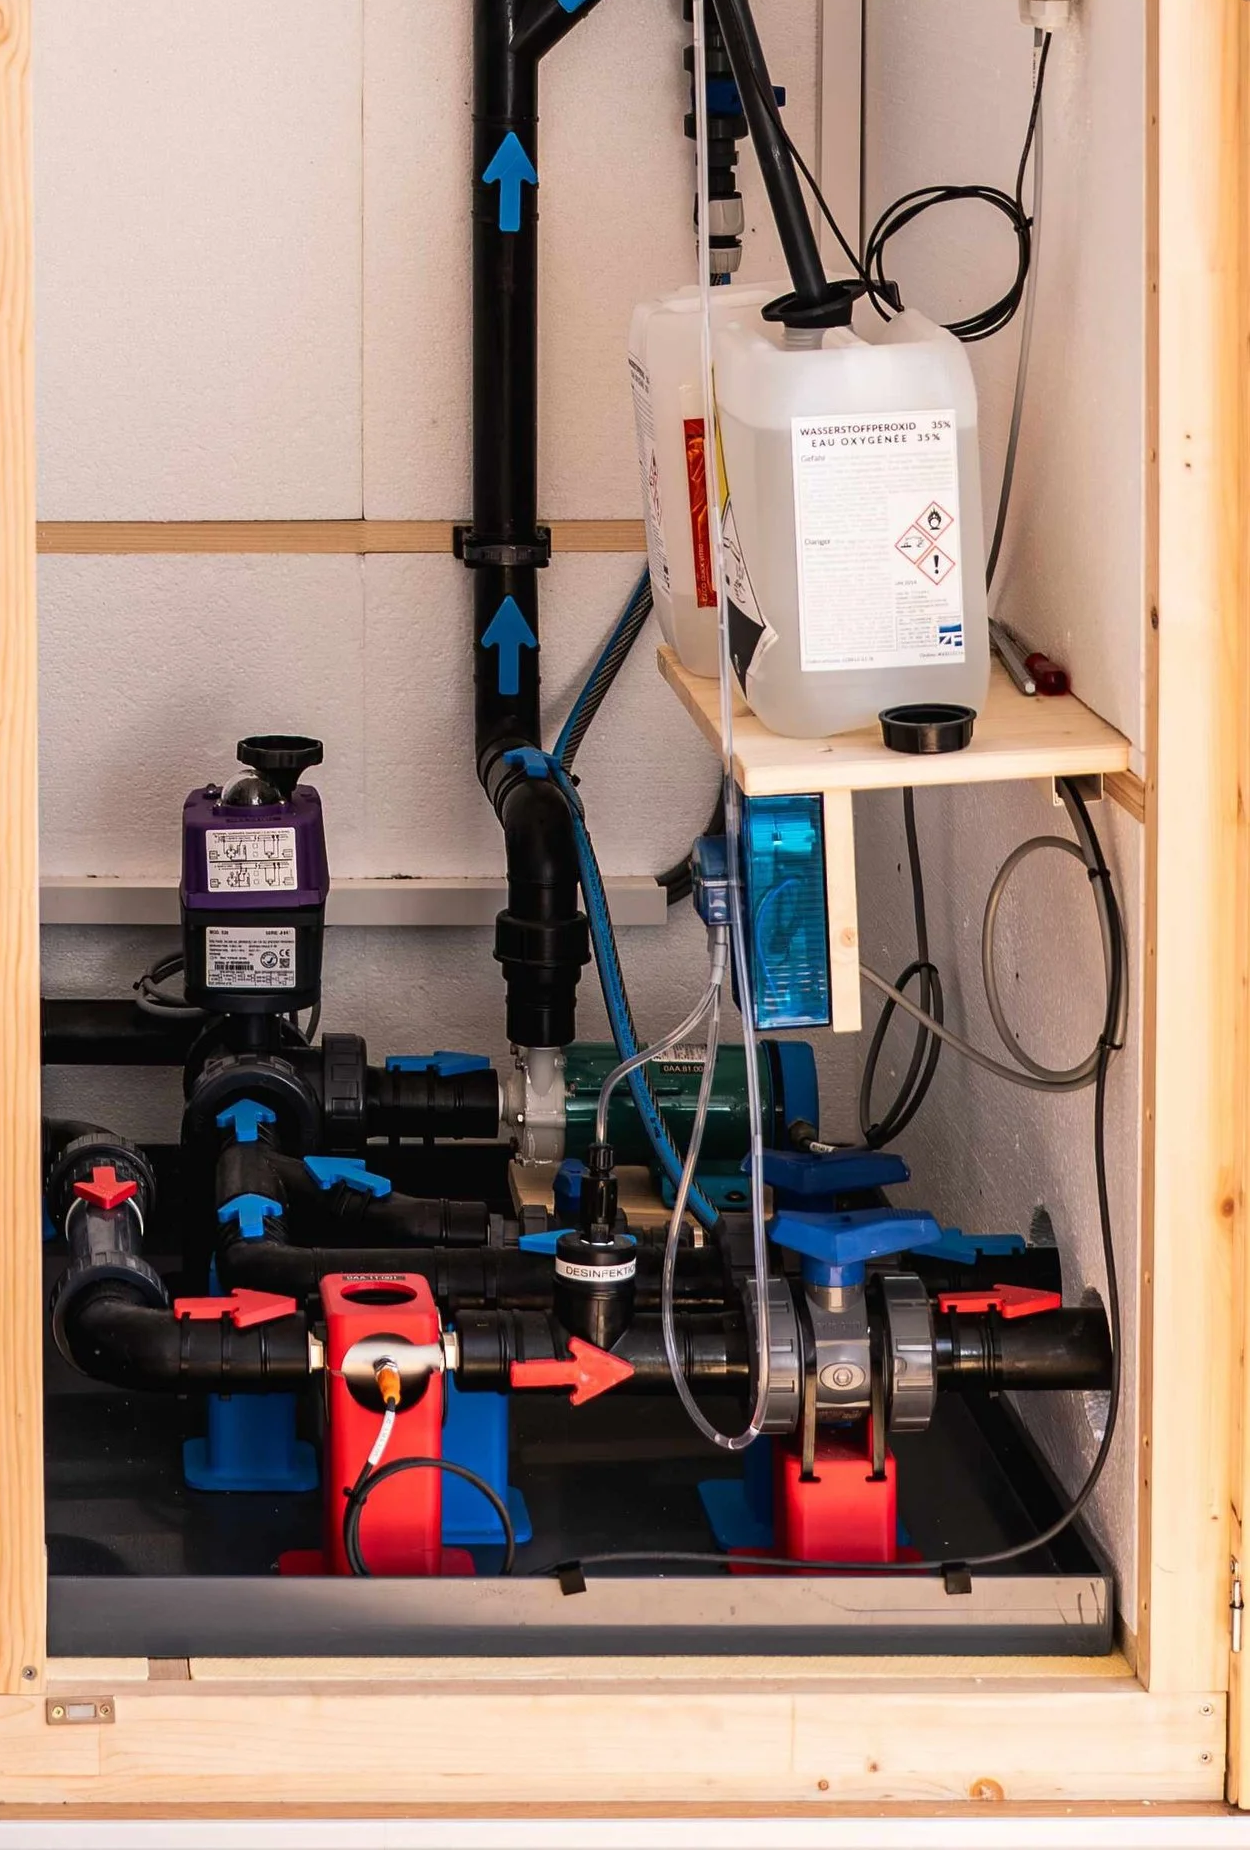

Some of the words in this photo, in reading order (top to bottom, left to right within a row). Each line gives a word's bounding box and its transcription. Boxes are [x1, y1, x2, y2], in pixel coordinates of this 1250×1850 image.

[800, 422, 916, 436] WASSERSTOFFPEROXID
[932, 420, 950, 429] 35%
[812, 439, 835, 447] EAU
[841, 435, 907, 446] OXYGÉNÉE
[918, 433, 940, 442] 35%
